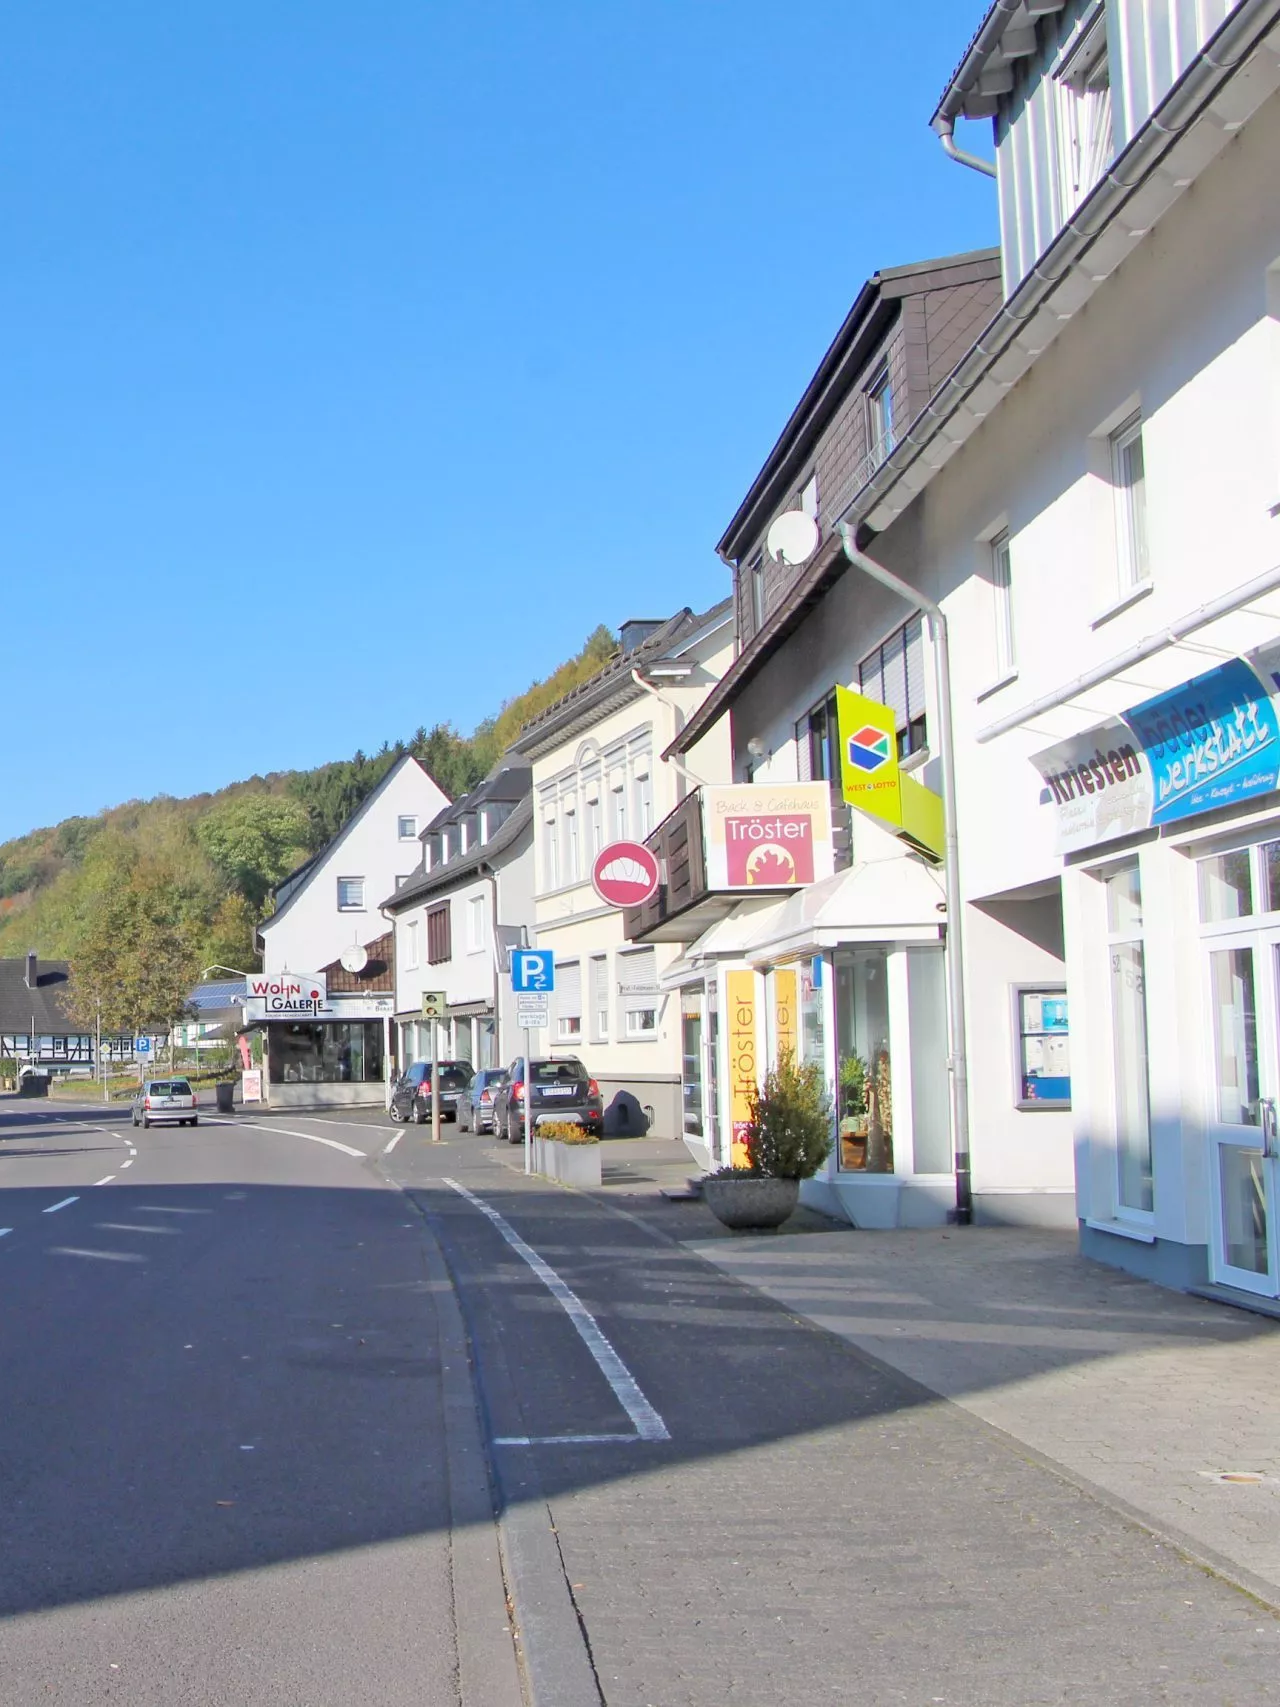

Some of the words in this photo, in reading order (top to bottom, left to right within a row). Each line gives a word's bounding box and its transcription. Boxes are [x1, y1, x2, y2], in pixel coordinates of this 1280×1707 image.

[847, 784, 866, 792] WEST
[873, 781, 897, 790] LOTTO
[716, 798, 748, 813] Back
[728, 819, 808, 841] Tröster
[521, 955, 544, 987] P
[732, 996, 754, 1098] Tröster
